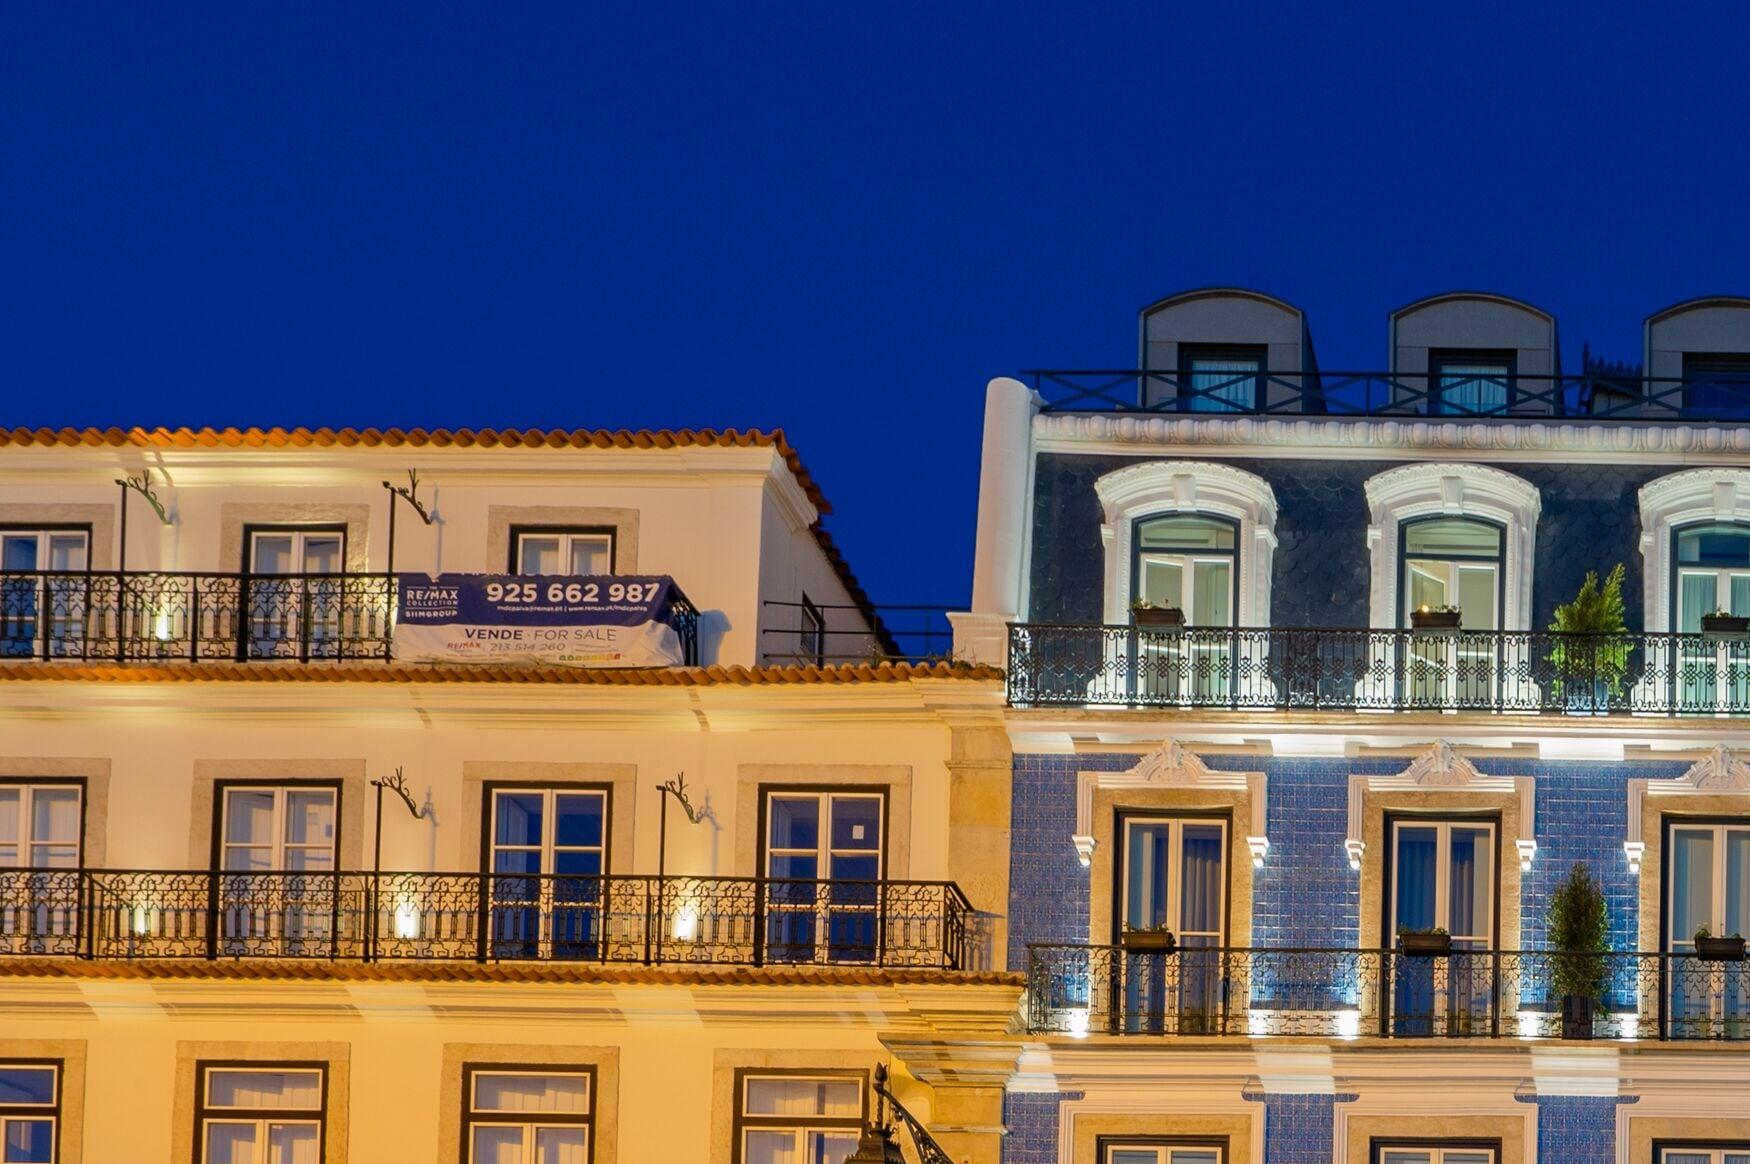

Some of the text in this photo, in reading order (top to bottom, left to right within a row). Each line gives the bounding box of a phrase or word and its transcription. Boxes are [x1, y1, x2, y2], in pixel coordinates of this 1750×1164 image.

[406, 590, 458, 600] RE/MAX
[486, 582, 660, 602] 925 662 987
[465, 628, 617, 642] VENDE FOR SALE
[489, 643, 511, 651] 213
[539, 643, 566, 651] 260
